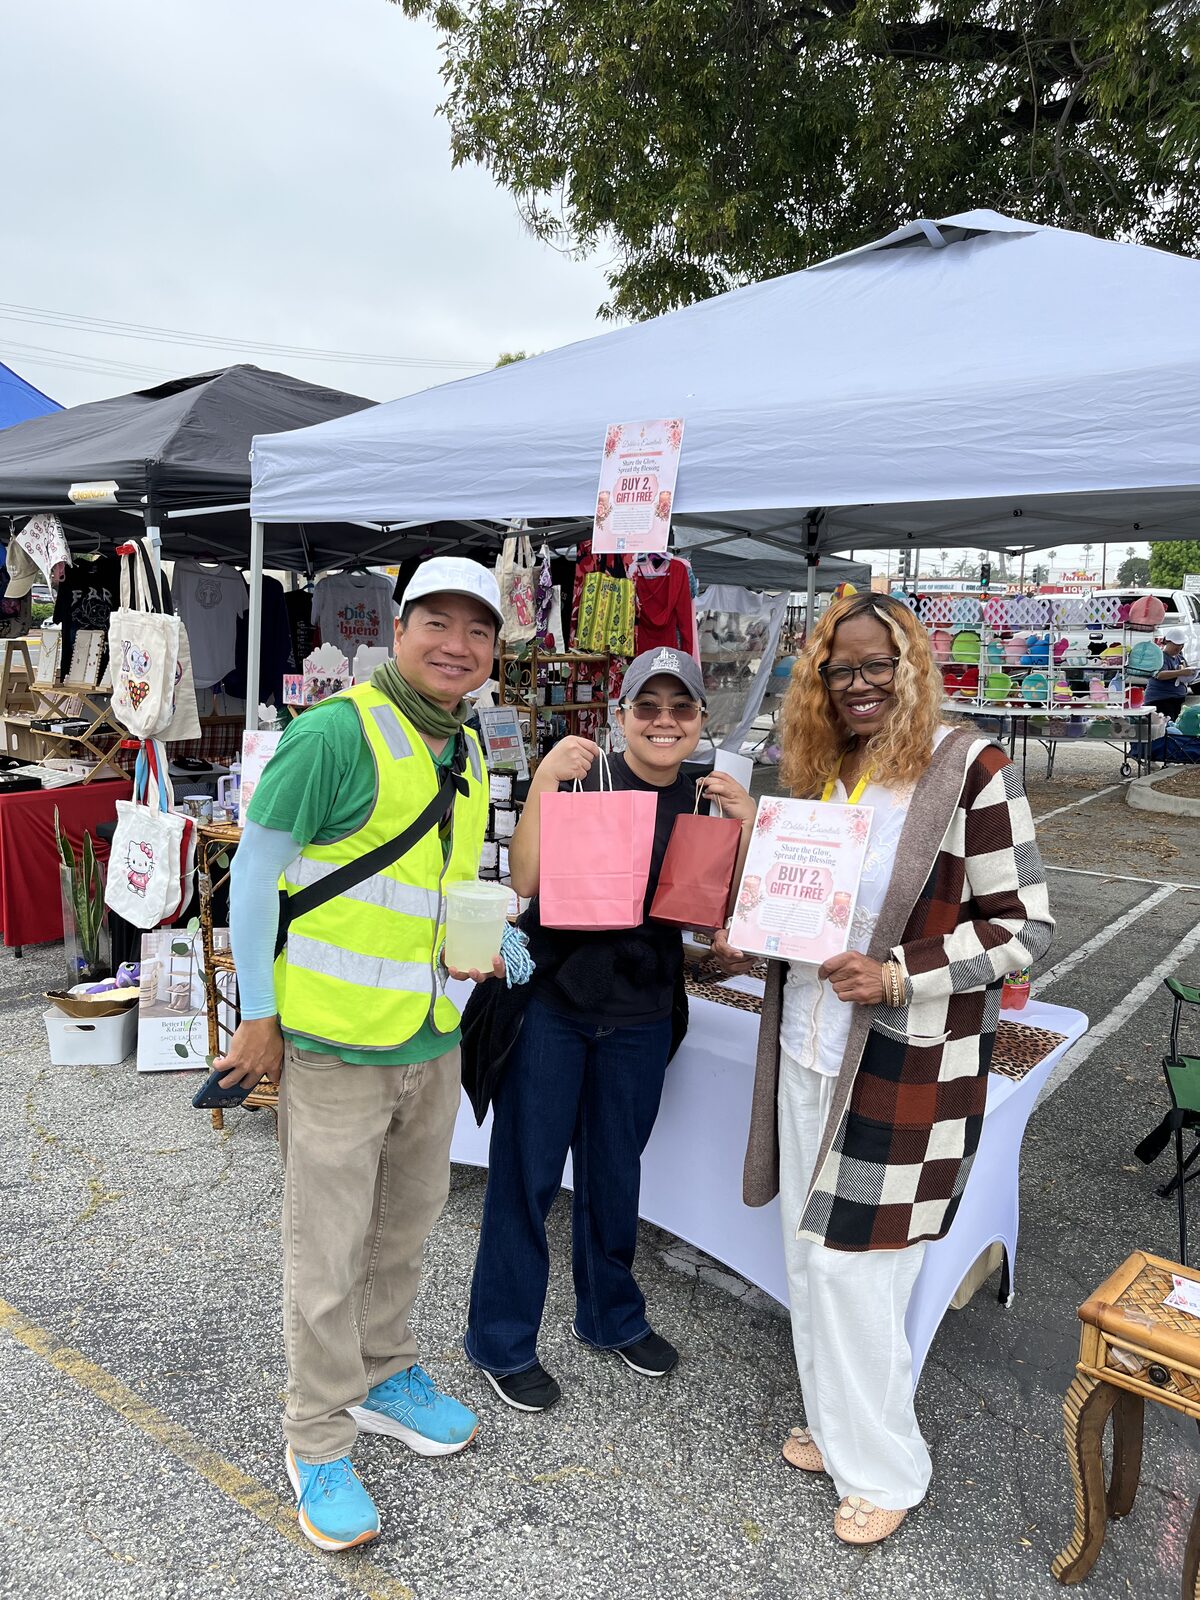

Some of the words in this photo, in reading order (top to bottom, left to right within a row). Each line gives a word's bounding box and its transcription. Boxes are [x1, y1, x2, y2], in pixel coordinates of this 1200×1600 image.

[618, 466, 633, 474] Spread
[621, 477, 641, 491] BUY
[642, 477, 651, 490] 2,
[616, 492, 631, 503] GIFT
[636, 491, 653, 502] FREE
[344, 607, 373, 621] Dios
[340, 621, 379, 637] bueno
[354, 619, 365, 627] es
[780, 843, 800, 854] Share
[800, 845, 812, 855] the
[812, 847, 832, 858] Glow,
[773, 851, 797, 861] Spread
[808, 855, 837, 866] Blessing
[777, 865, 808, 884] BUY
[808, 869, 823, 888] 2,
[770, 882, 792, 896] GIFT
[792, 884, 798, 897] 1
[799, 885, 825, 901] FREE
[161, 1020, 180, 1028] Better
